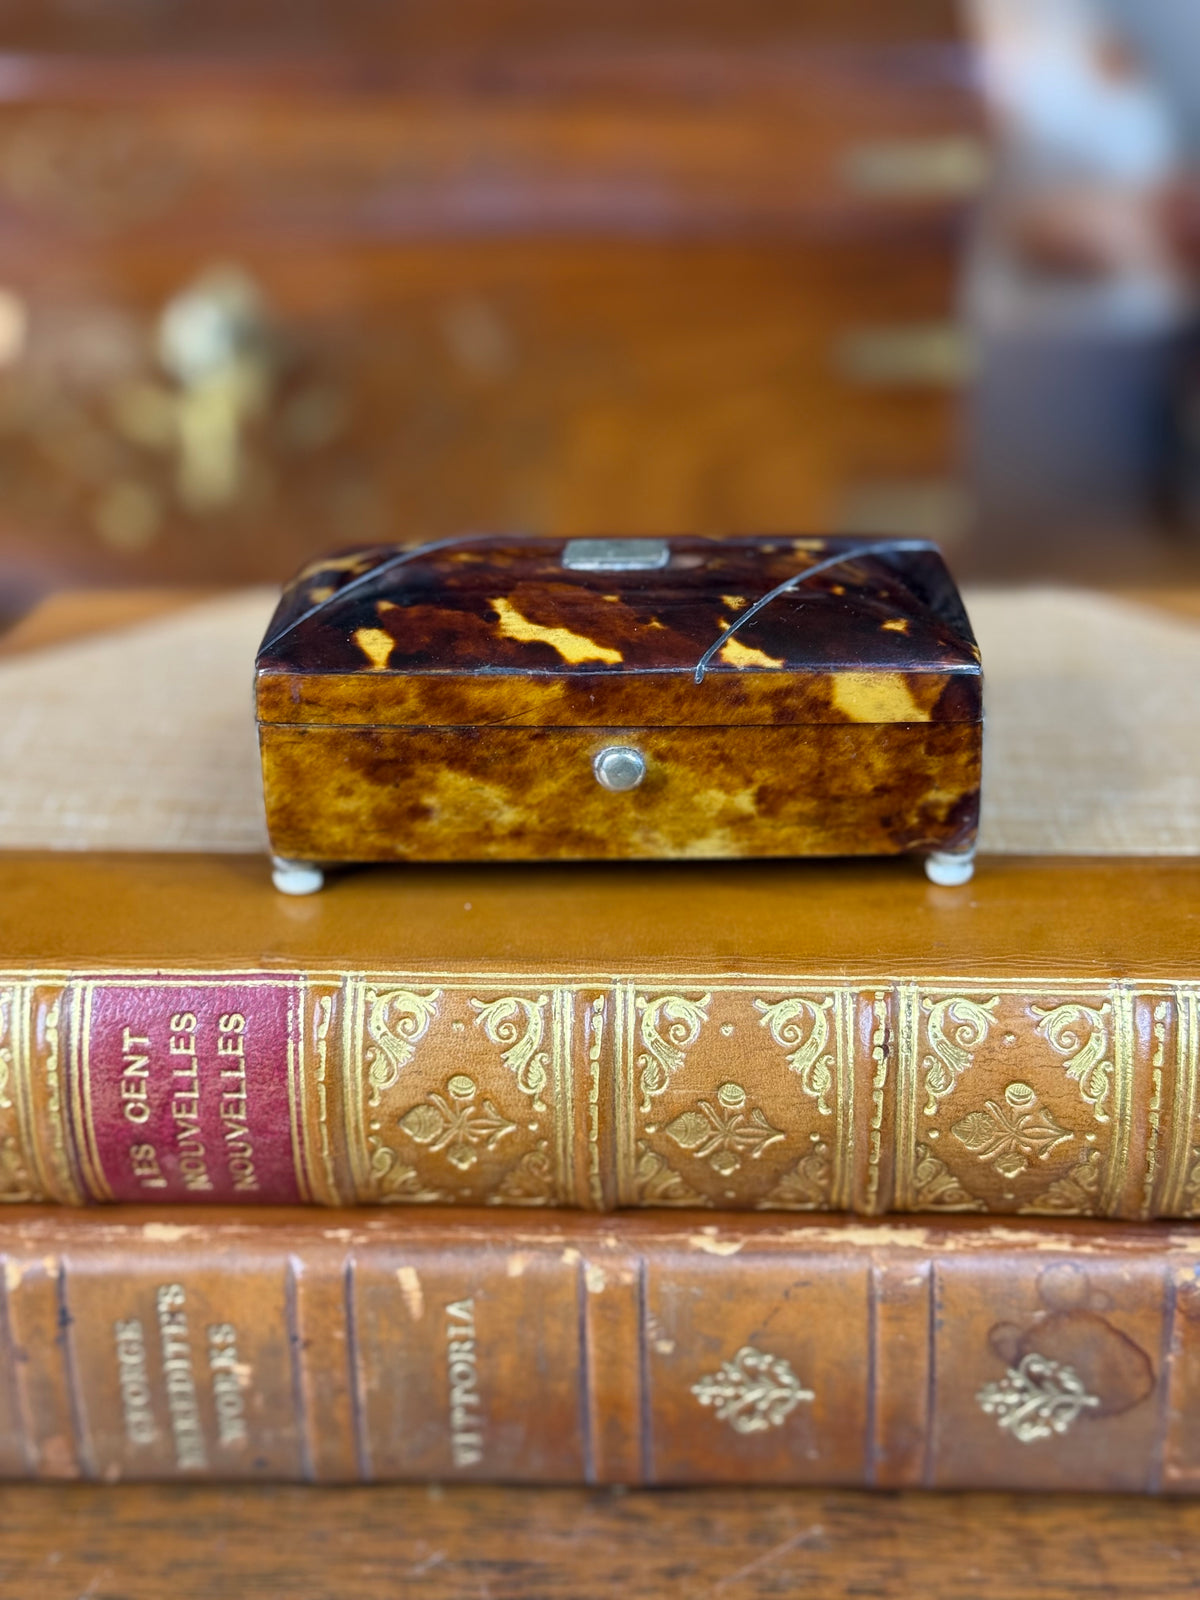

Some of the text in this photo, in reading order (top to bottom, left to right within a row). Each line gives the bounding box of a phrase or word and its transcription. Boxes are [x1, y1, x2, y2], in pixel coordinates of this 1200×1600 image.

[121, 1026, 151, 1124] CENT
[169, 1012, 214, 1191] NOUVELLES
[217, 1012, 260, 1191] NOUVELLES
